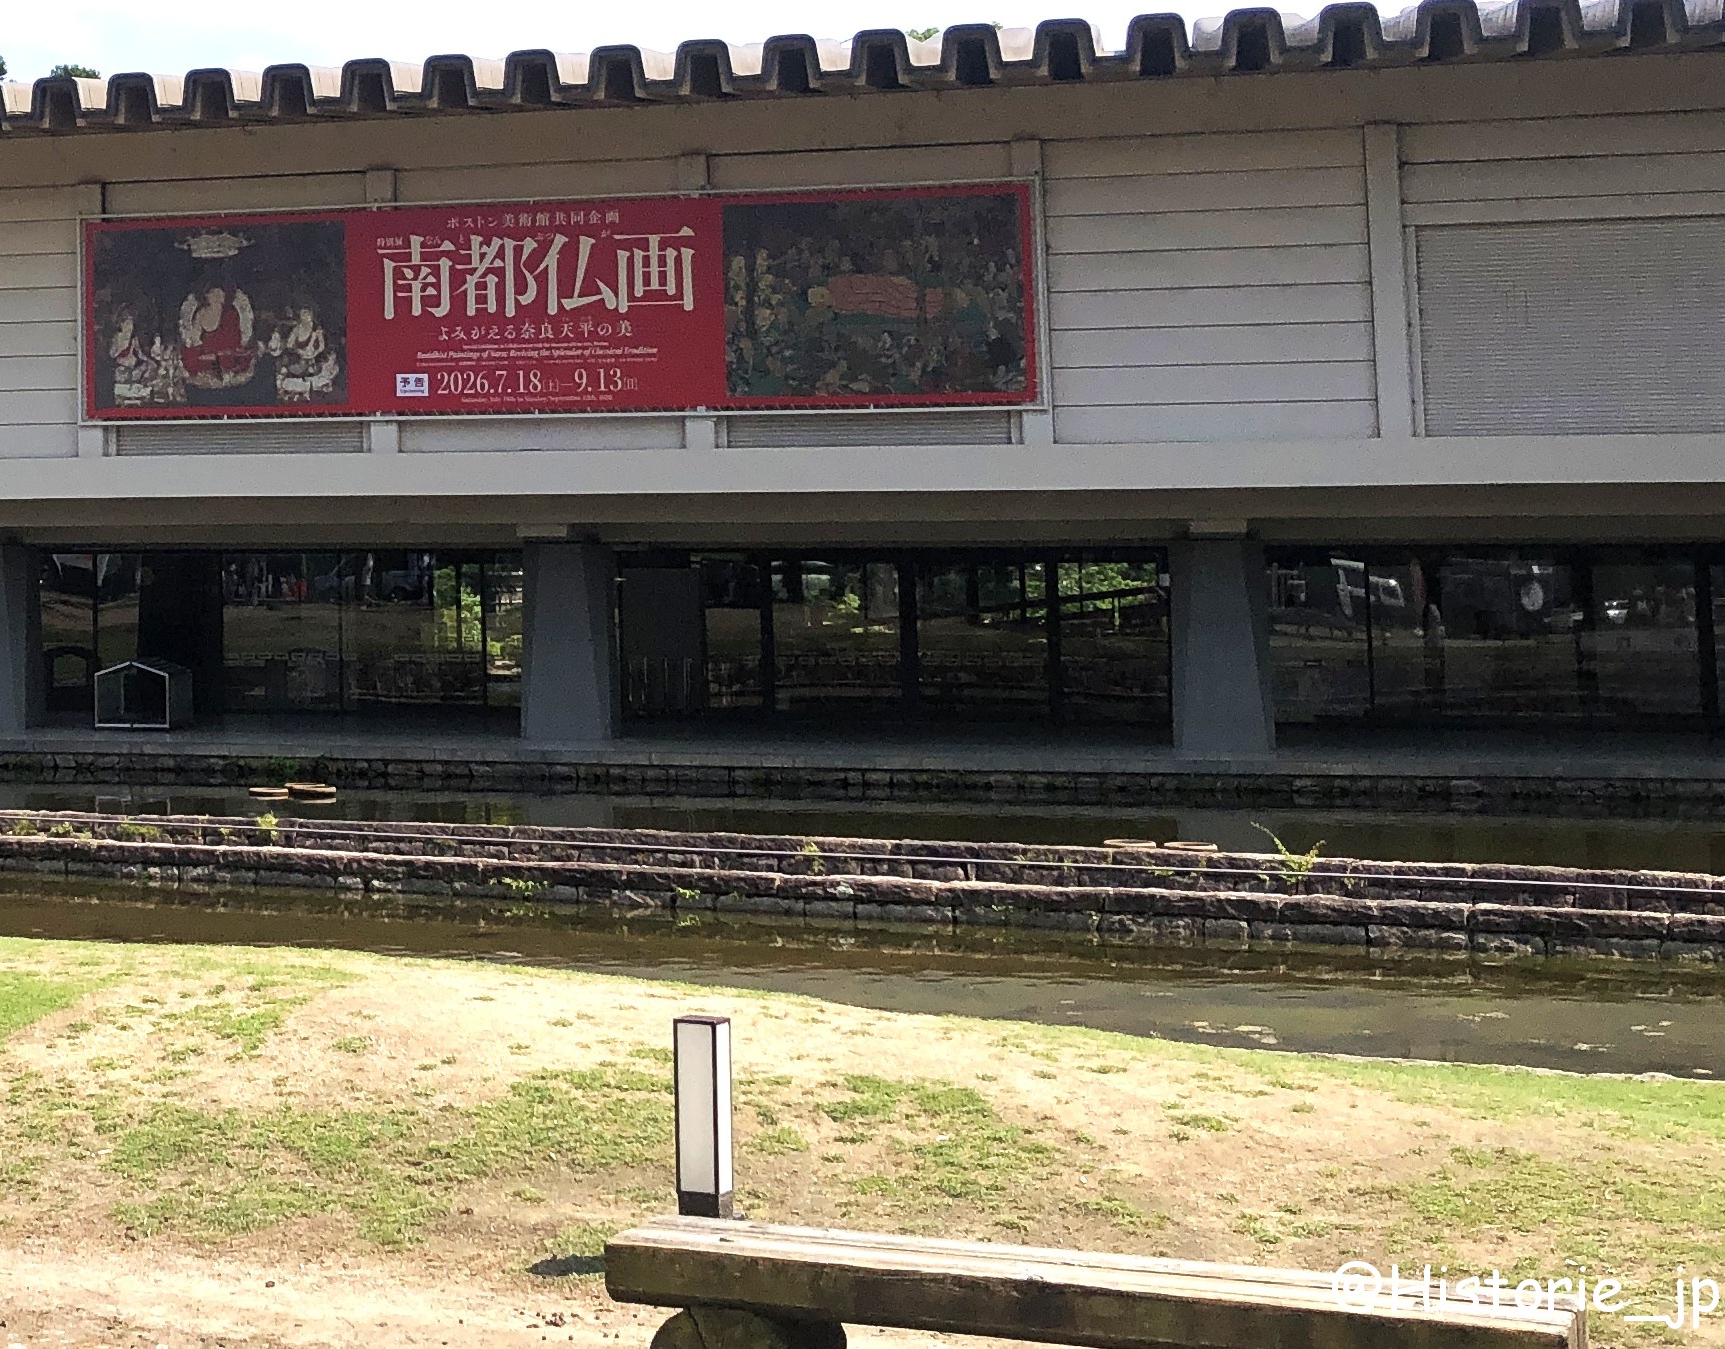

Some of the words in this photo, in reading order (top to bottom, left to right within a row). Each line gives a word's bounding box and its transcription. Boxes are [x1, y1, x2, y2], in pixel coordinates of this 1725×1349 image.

[376, 226, 695, 320] 南都仏画
[438, 319, 633, 340] よみがえる奈良天平の美
